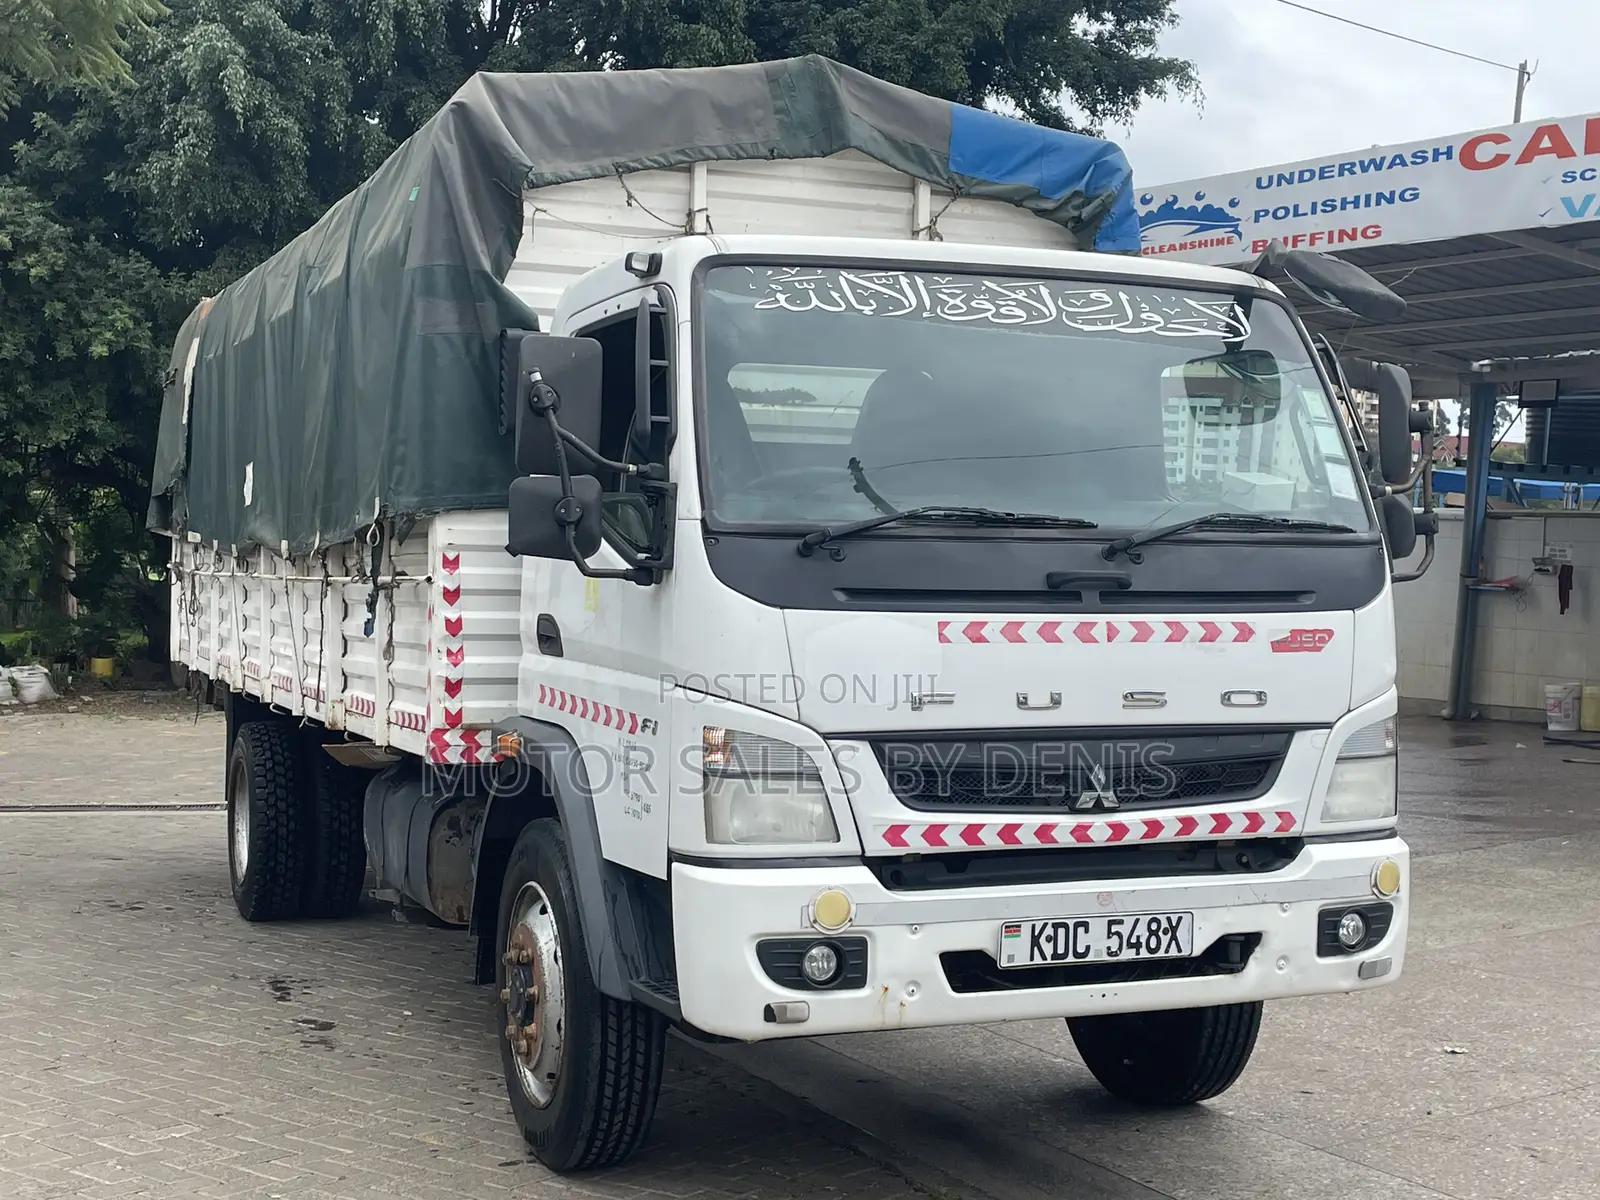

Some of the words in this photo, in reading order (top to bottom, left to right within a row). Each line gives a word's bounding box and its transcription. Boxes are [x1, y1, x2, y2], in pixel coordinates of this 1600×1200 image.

[1256, 145, 1453, 190] UNDERWASH
[1254, 187, 1420, 223] POLISHING
[1560, 193, 1600, 218] V
[1142, 236, 1235, 256] CLEANSHINE
[911, 689, 1268, 712] FUSO
[1029, 920, 1091, 962] KDC
[1106, 915, 1183, 958] 548X
